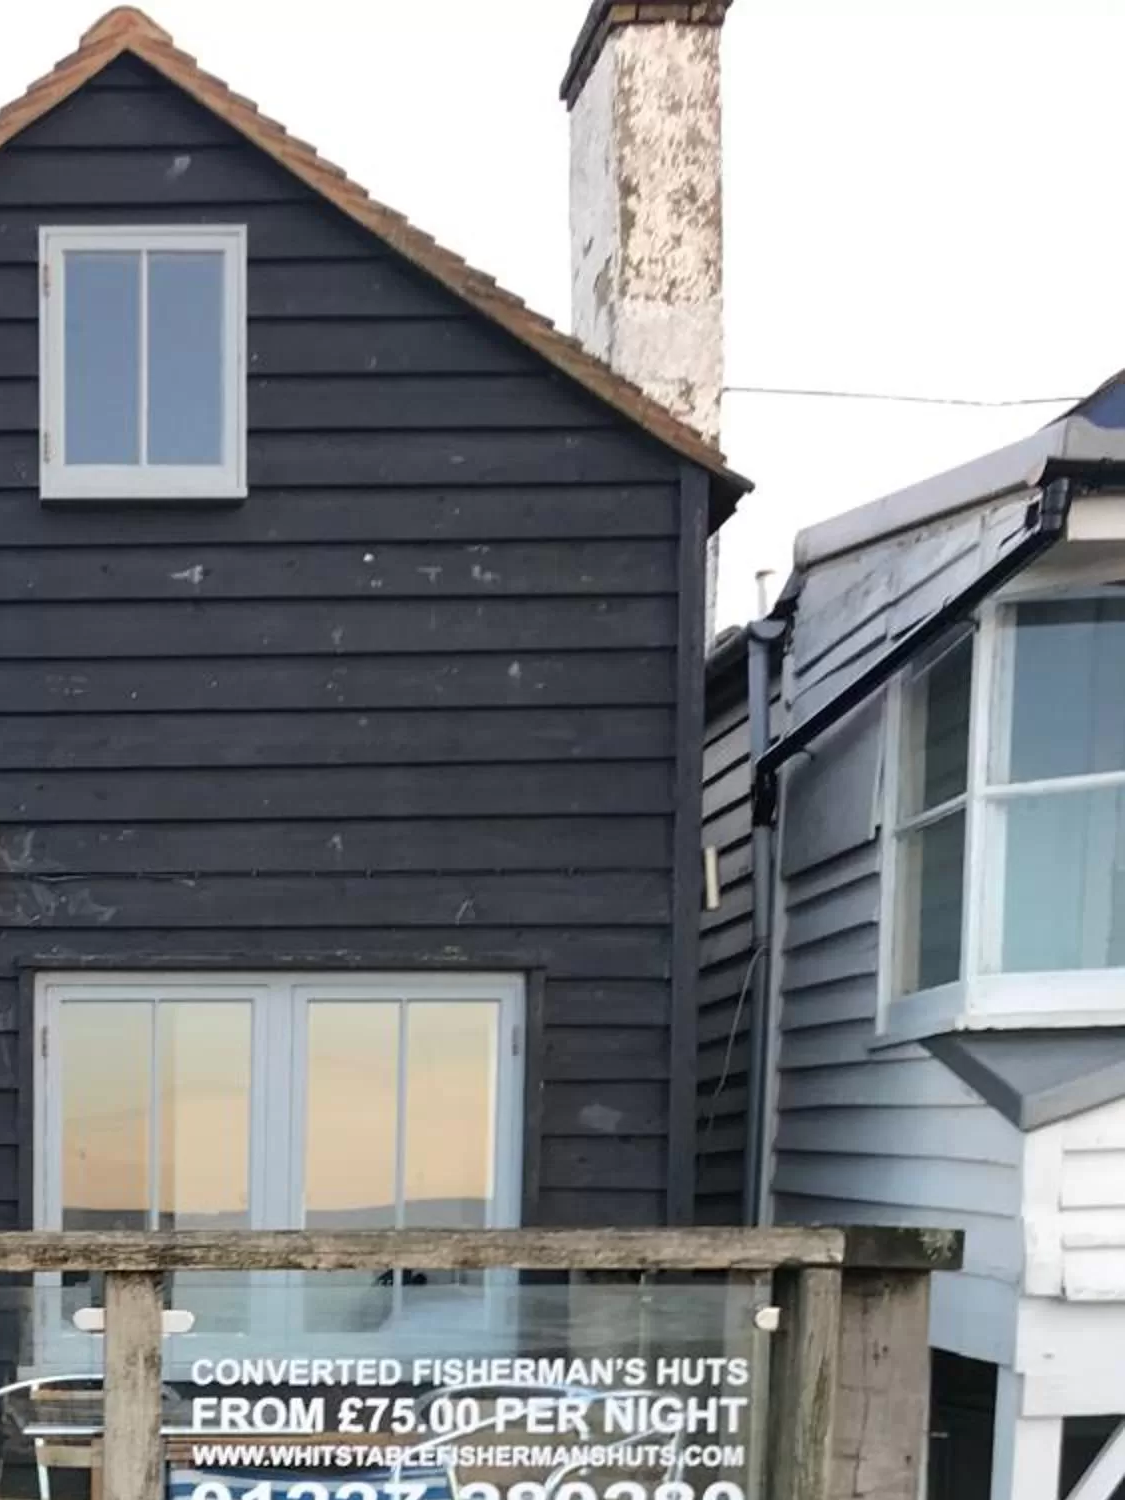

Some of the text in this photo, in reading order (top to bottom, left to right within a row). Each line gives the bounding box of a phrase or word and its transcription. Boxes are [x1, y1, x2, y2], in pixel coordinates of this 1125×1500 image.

[191, 1358, 749, 1386] CONVERTED FISHERMAN'S HUTS
[192, 1397, 748, 1433] FROM £75.00 PER NIGHT
[192, 1444, 745, 1468] WWW.WHITSTABLEFISHERMANSHUTS.COM
